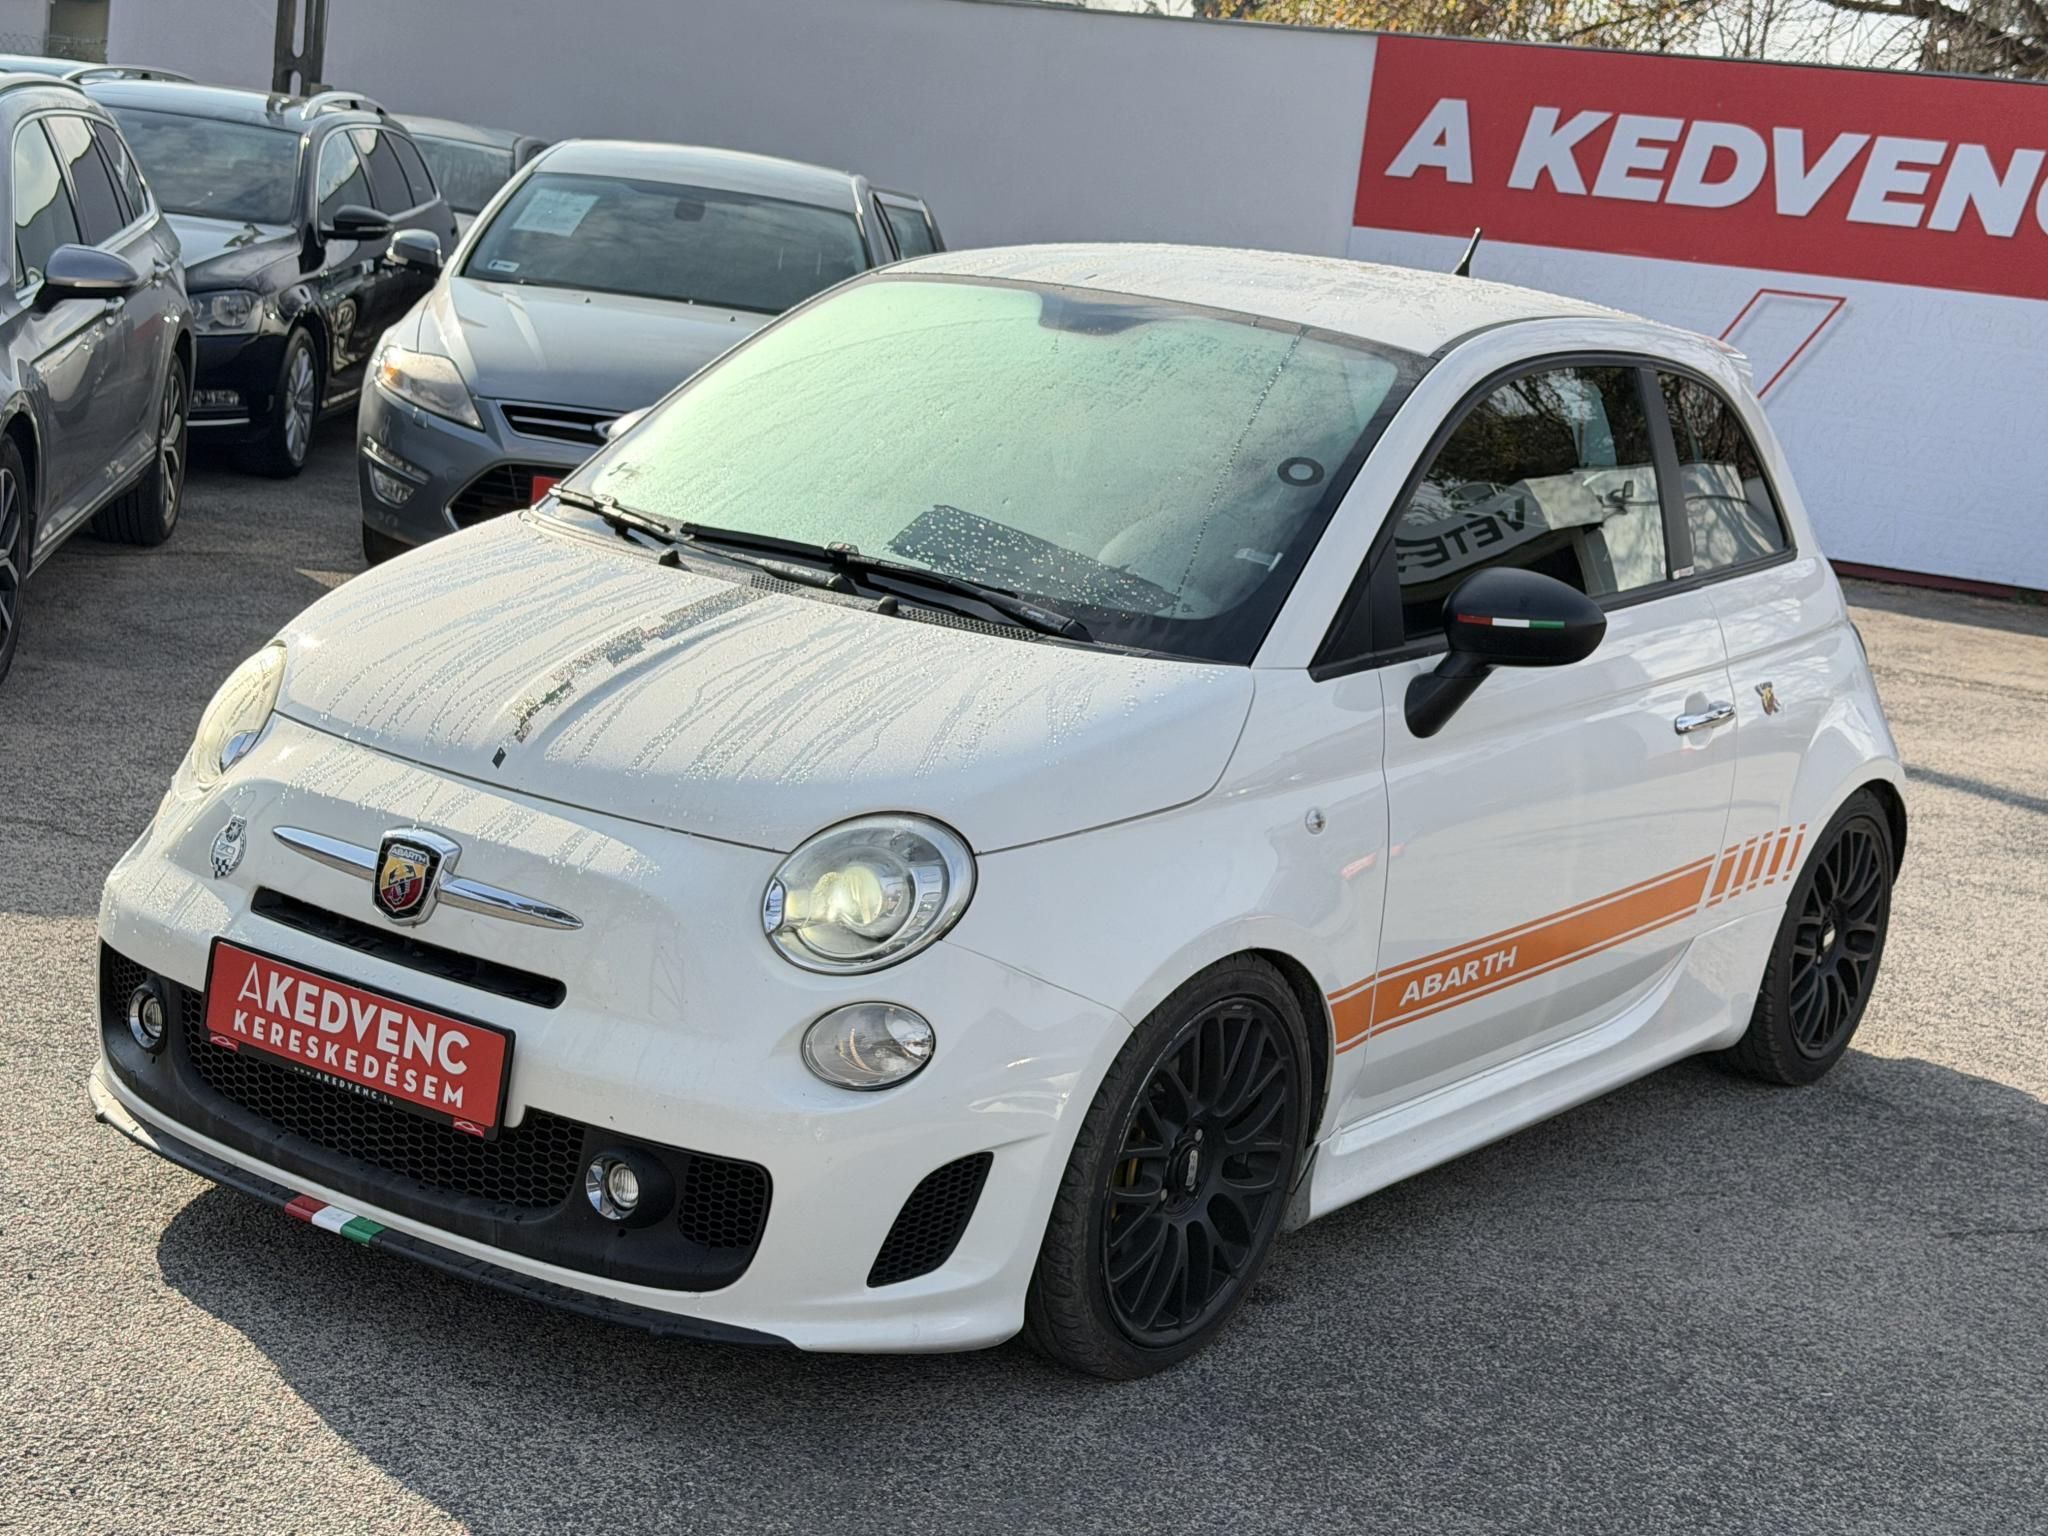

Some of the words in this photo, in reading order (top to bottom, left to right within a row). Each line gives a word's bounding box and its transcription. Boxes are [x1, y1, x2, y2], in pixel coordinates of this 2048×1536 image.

[1384, 97, 1473, 184] A
[1507, 105, 2048, 237] KEDVEN
[390, 846, 427, 863] ABARTH
[1400, 945, 1518, 1008] ABARTH
[233, 1009, 464, 1109] KERESKEDÉSEM
